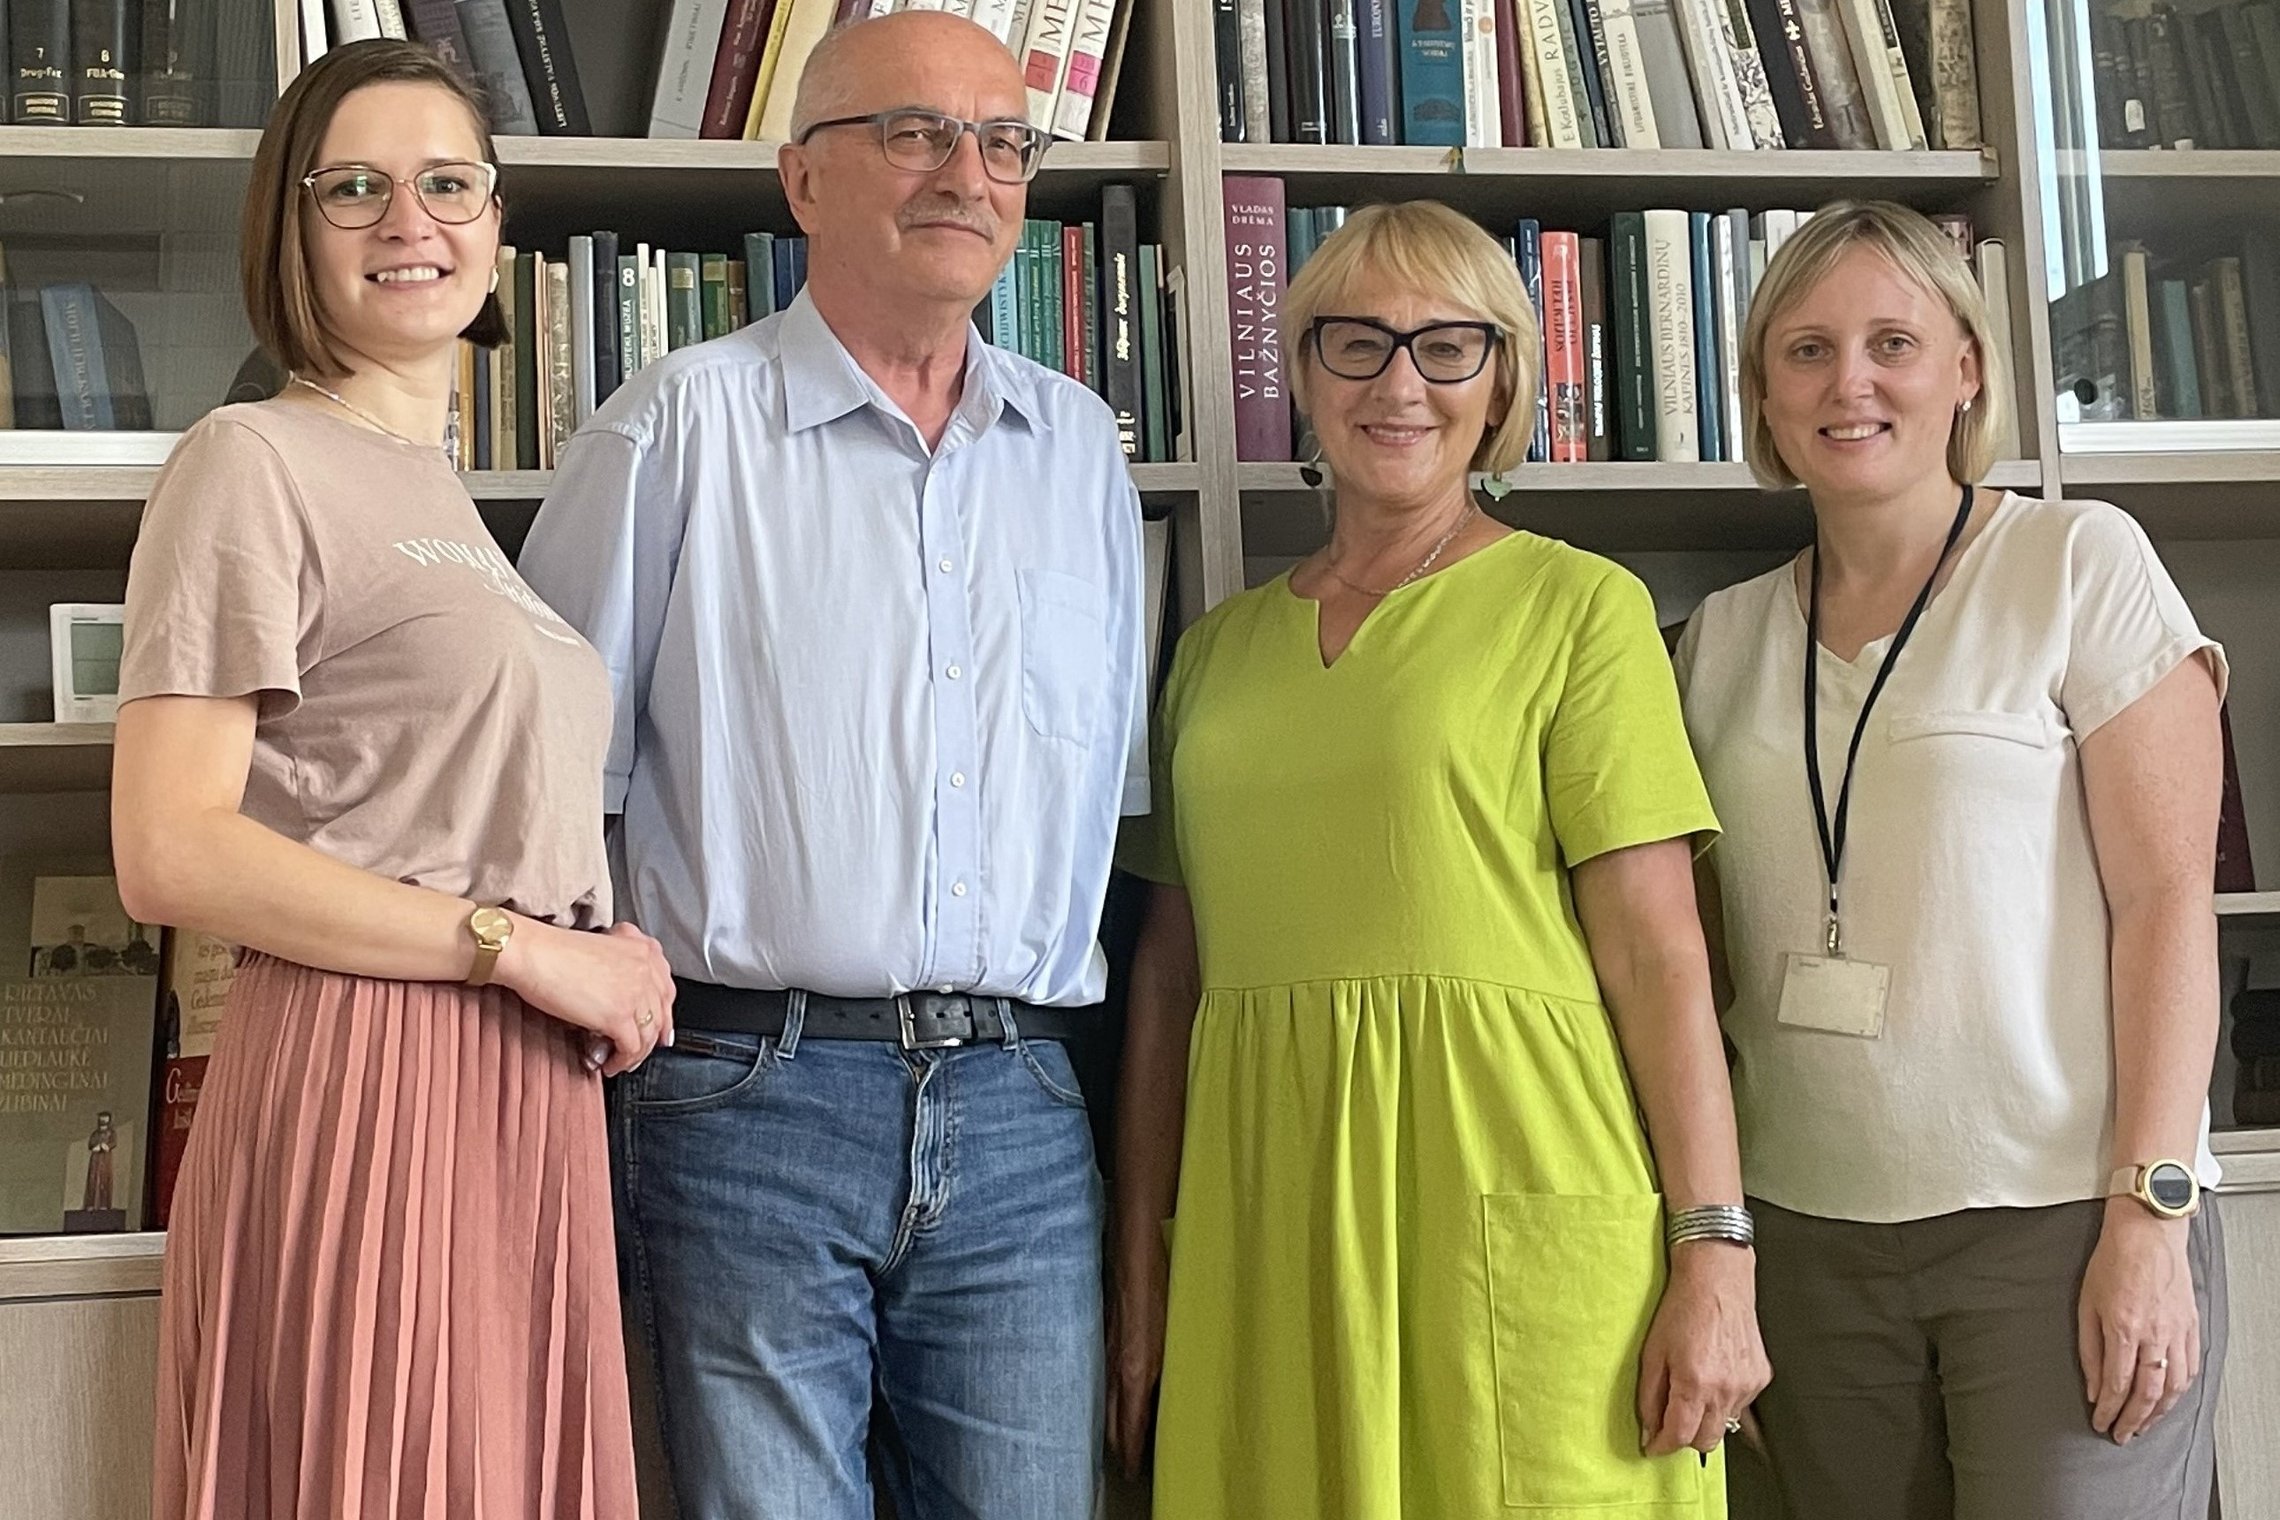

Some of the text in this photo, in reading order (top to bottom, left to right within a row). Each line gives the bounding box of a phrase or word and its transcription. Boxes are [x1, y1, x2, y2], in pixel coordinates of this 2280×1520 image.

[101, 49, 110, 62] 8
[1231, 204, 1275, 214] VLADAS
[1234, 243, 1256, 400] VILNIAUS
[1256, 244, 1280, 400] BAŽNYČIOS
[1653, 239, 1678, 416] VILNIAUS BERNARDINŲ
